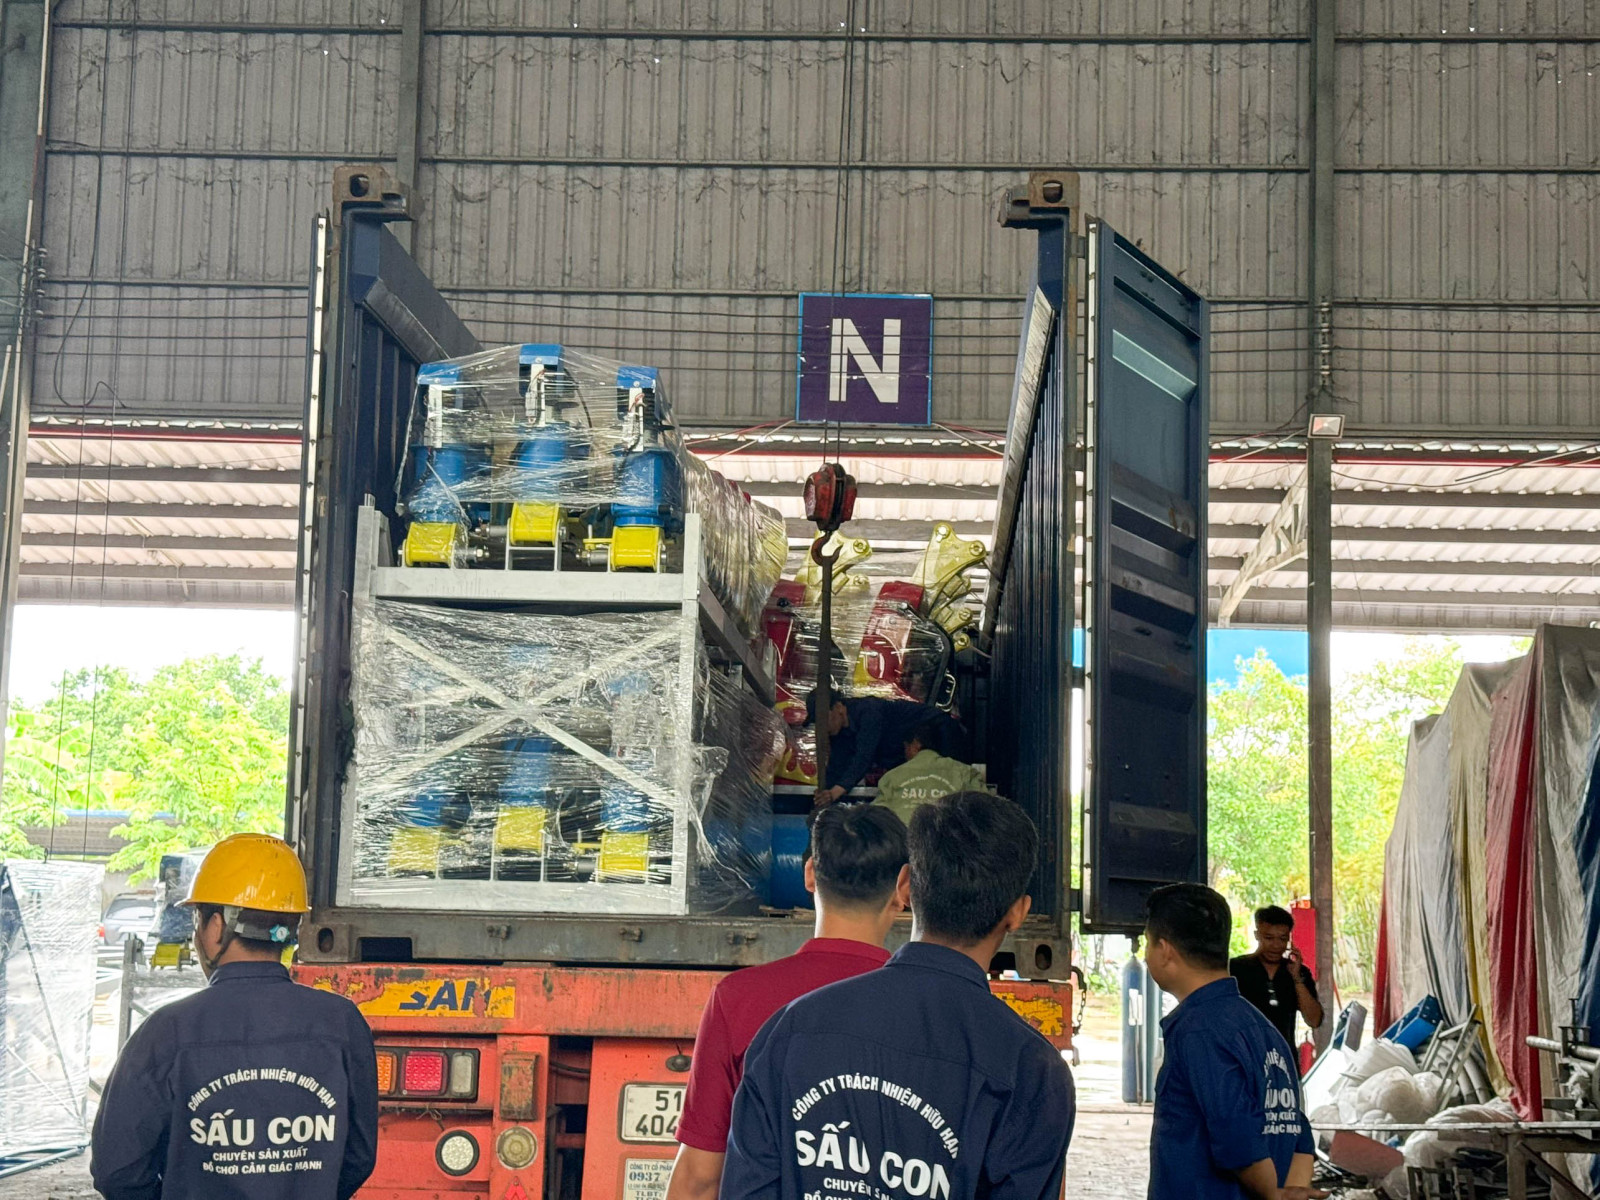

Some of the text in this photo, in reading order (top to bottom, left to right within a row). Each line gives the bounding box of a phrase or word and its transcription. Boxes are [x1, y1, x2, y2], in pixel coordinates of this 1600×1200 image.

[829, 318, 901, 403] N
[188, 1068, 336, 1112] CÔNG TY TRÁCH NHIỆM HỮU HẠN
[792, 1087, 822, 1121] CÔNG
[819, 1078, 836, 1095] TY
[838, 1072, 879, 1090] TRÁCH
[881, 1080, 922, 1111] NHIỆM
[920, 1104, 946, 1130] HỮU
[190, 1108, 336, 1146] SẤU CON
[212, 1145, 308, 1162] CHUYÊN SẢN XUẤT
[794, 1121, 870, 1174] SẤU
[202, 1160, 322, 1175] ĐỒ CHƠI CẢM GIÁC MẠNH
[629, 1171, 660, 1182] 0937
[823, 1177, 872, 1196] CHUYÊN
